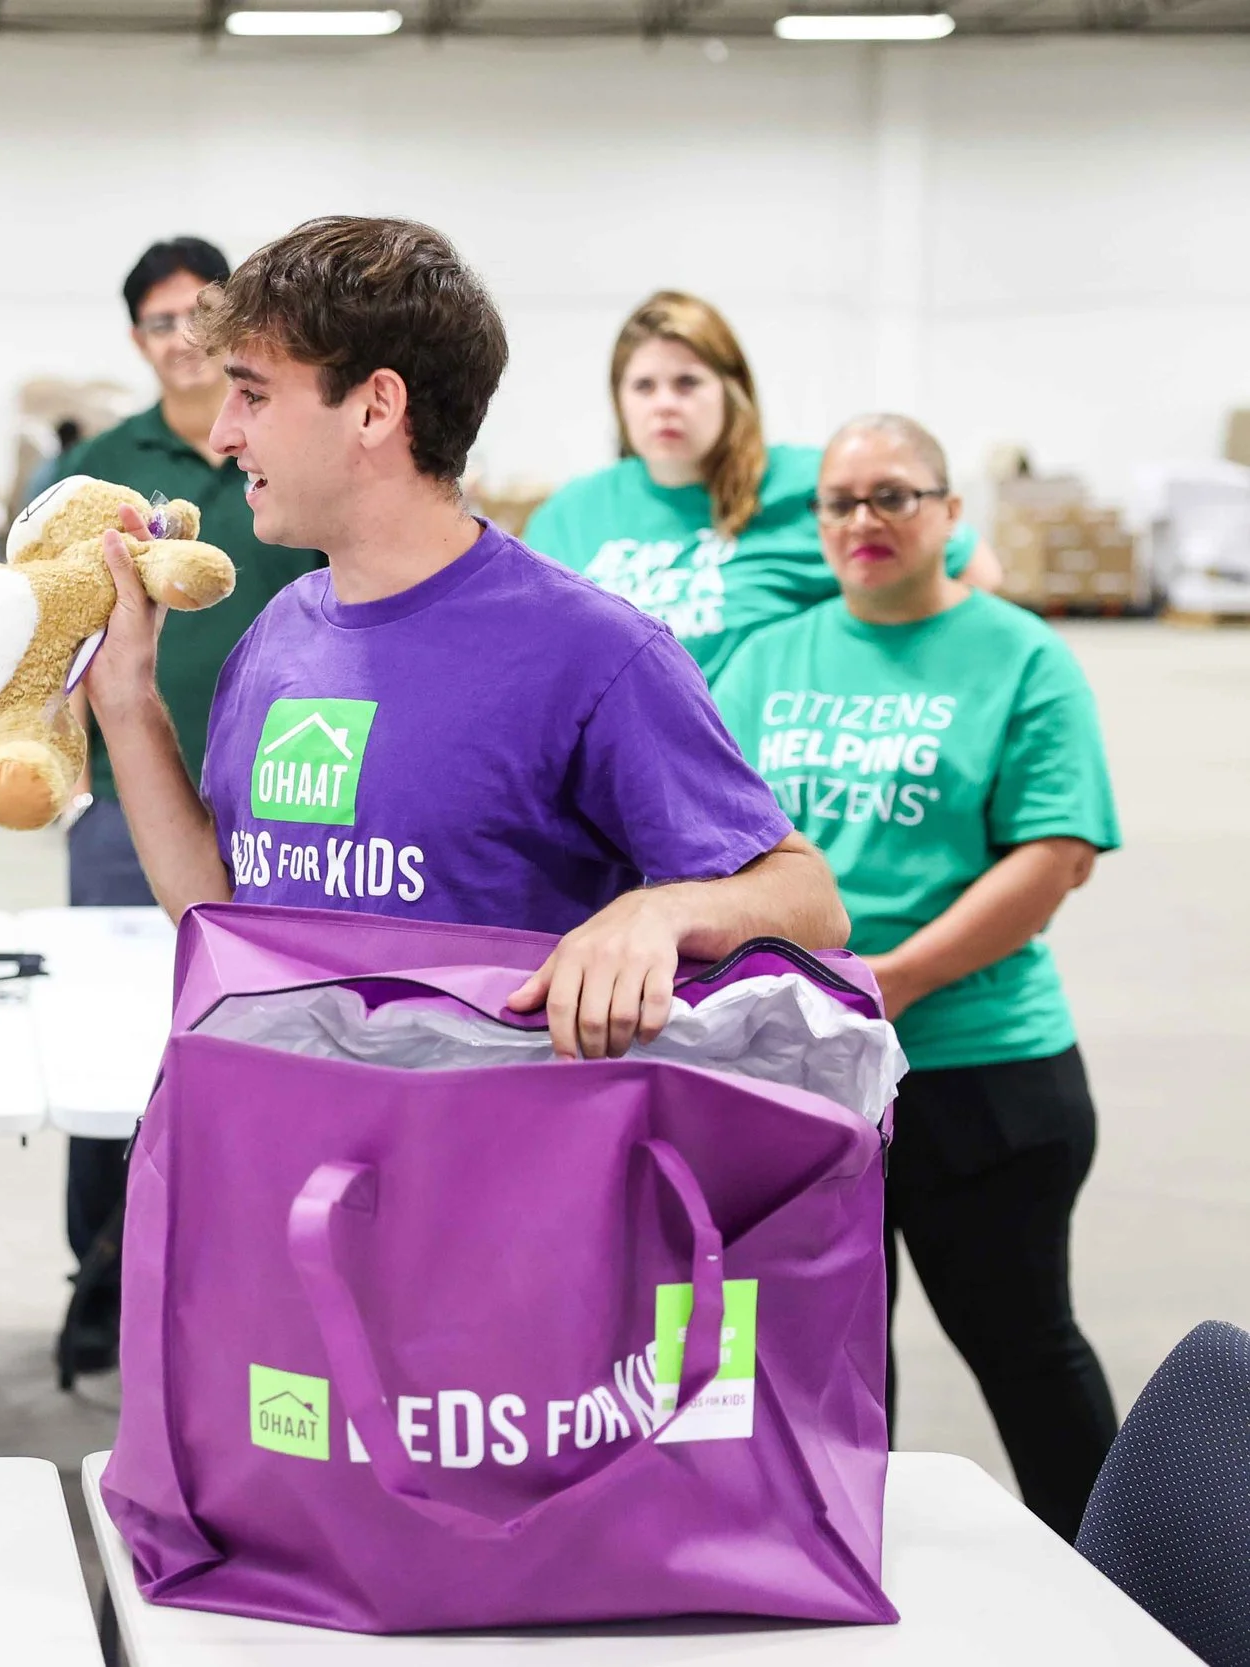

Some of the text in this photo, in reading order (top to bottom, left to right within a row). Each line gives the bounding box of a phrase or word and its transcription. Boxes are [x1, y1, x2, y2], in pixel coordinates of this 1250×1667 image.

[763, 689, 957, 732] CITIZENS
[758, 728, 941, 776] HELPING
[258, 760, 348, 808] OHAAT
[278, 843, 320, 882] FOR
[324, 837, 425, 902] KIDS
[259, 1410, 319, 1441] OHAAT
[547, 1386, 631, 1457] FOR
